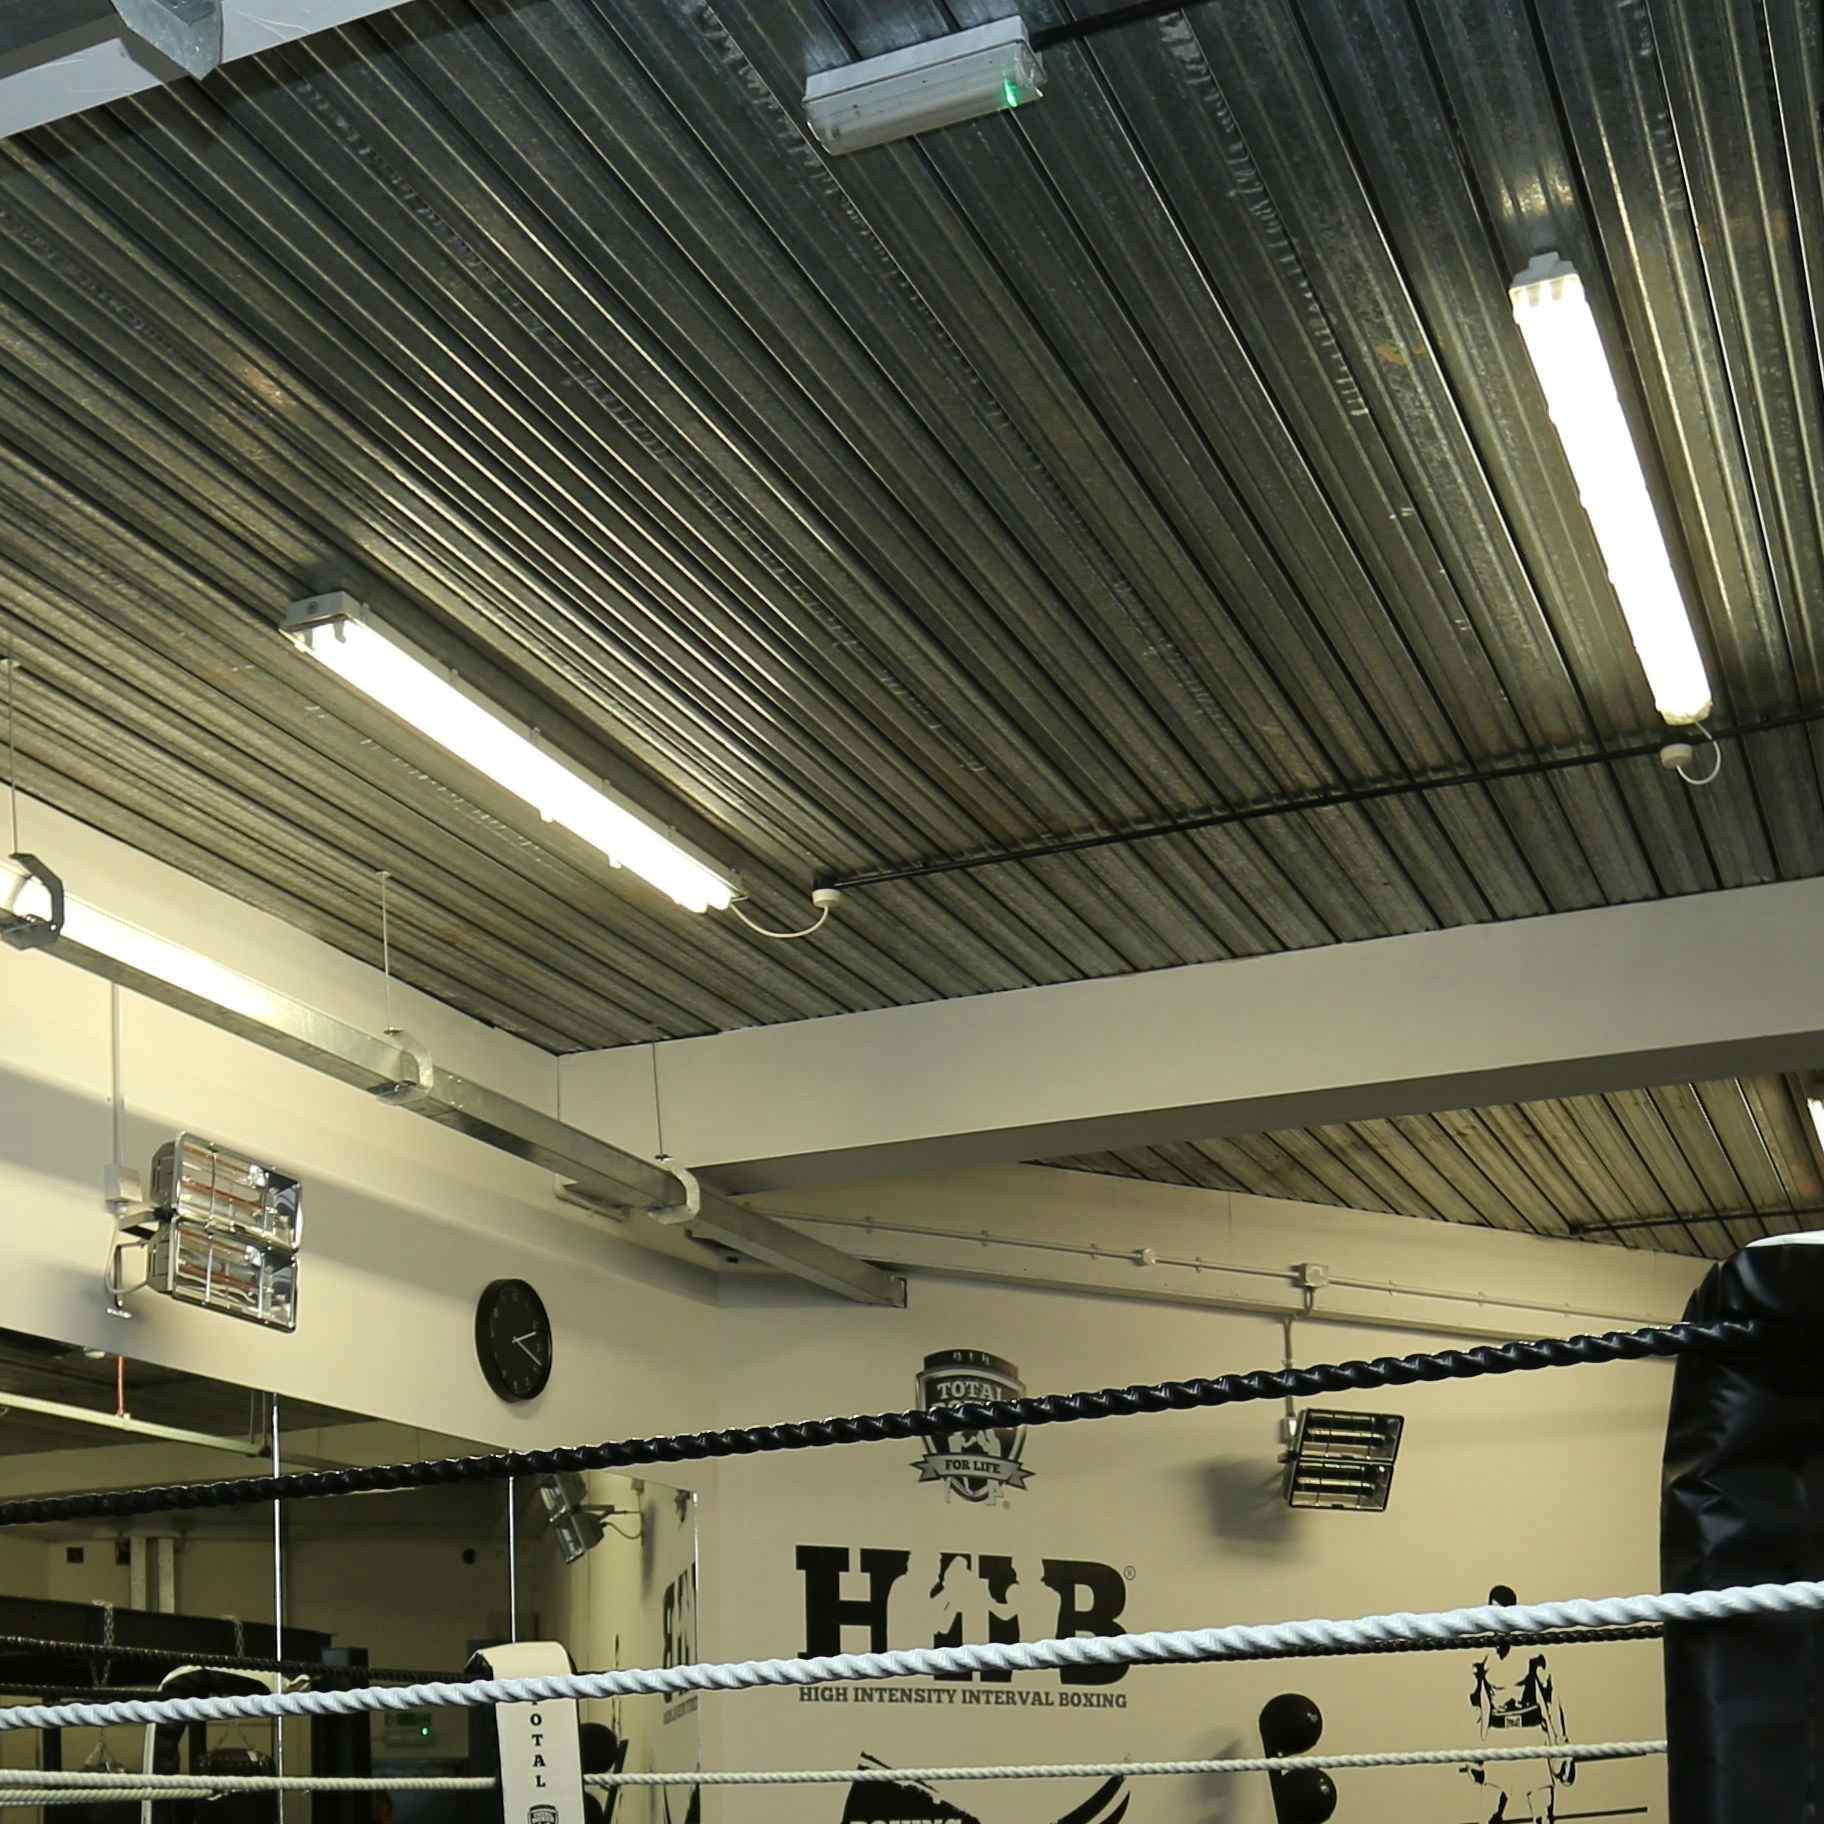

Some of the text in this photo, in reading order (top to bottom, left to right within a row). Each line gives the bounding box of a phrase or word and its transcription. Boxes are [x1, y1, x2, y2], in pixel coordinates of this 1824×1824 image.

[944, 1459, 1001, 1474] FOR LIFE
[799, 1686, 1128, 1709] HIGH INTENSITY INTERVAL BOXING
[530, 1700, 547, 1789] OTAL
